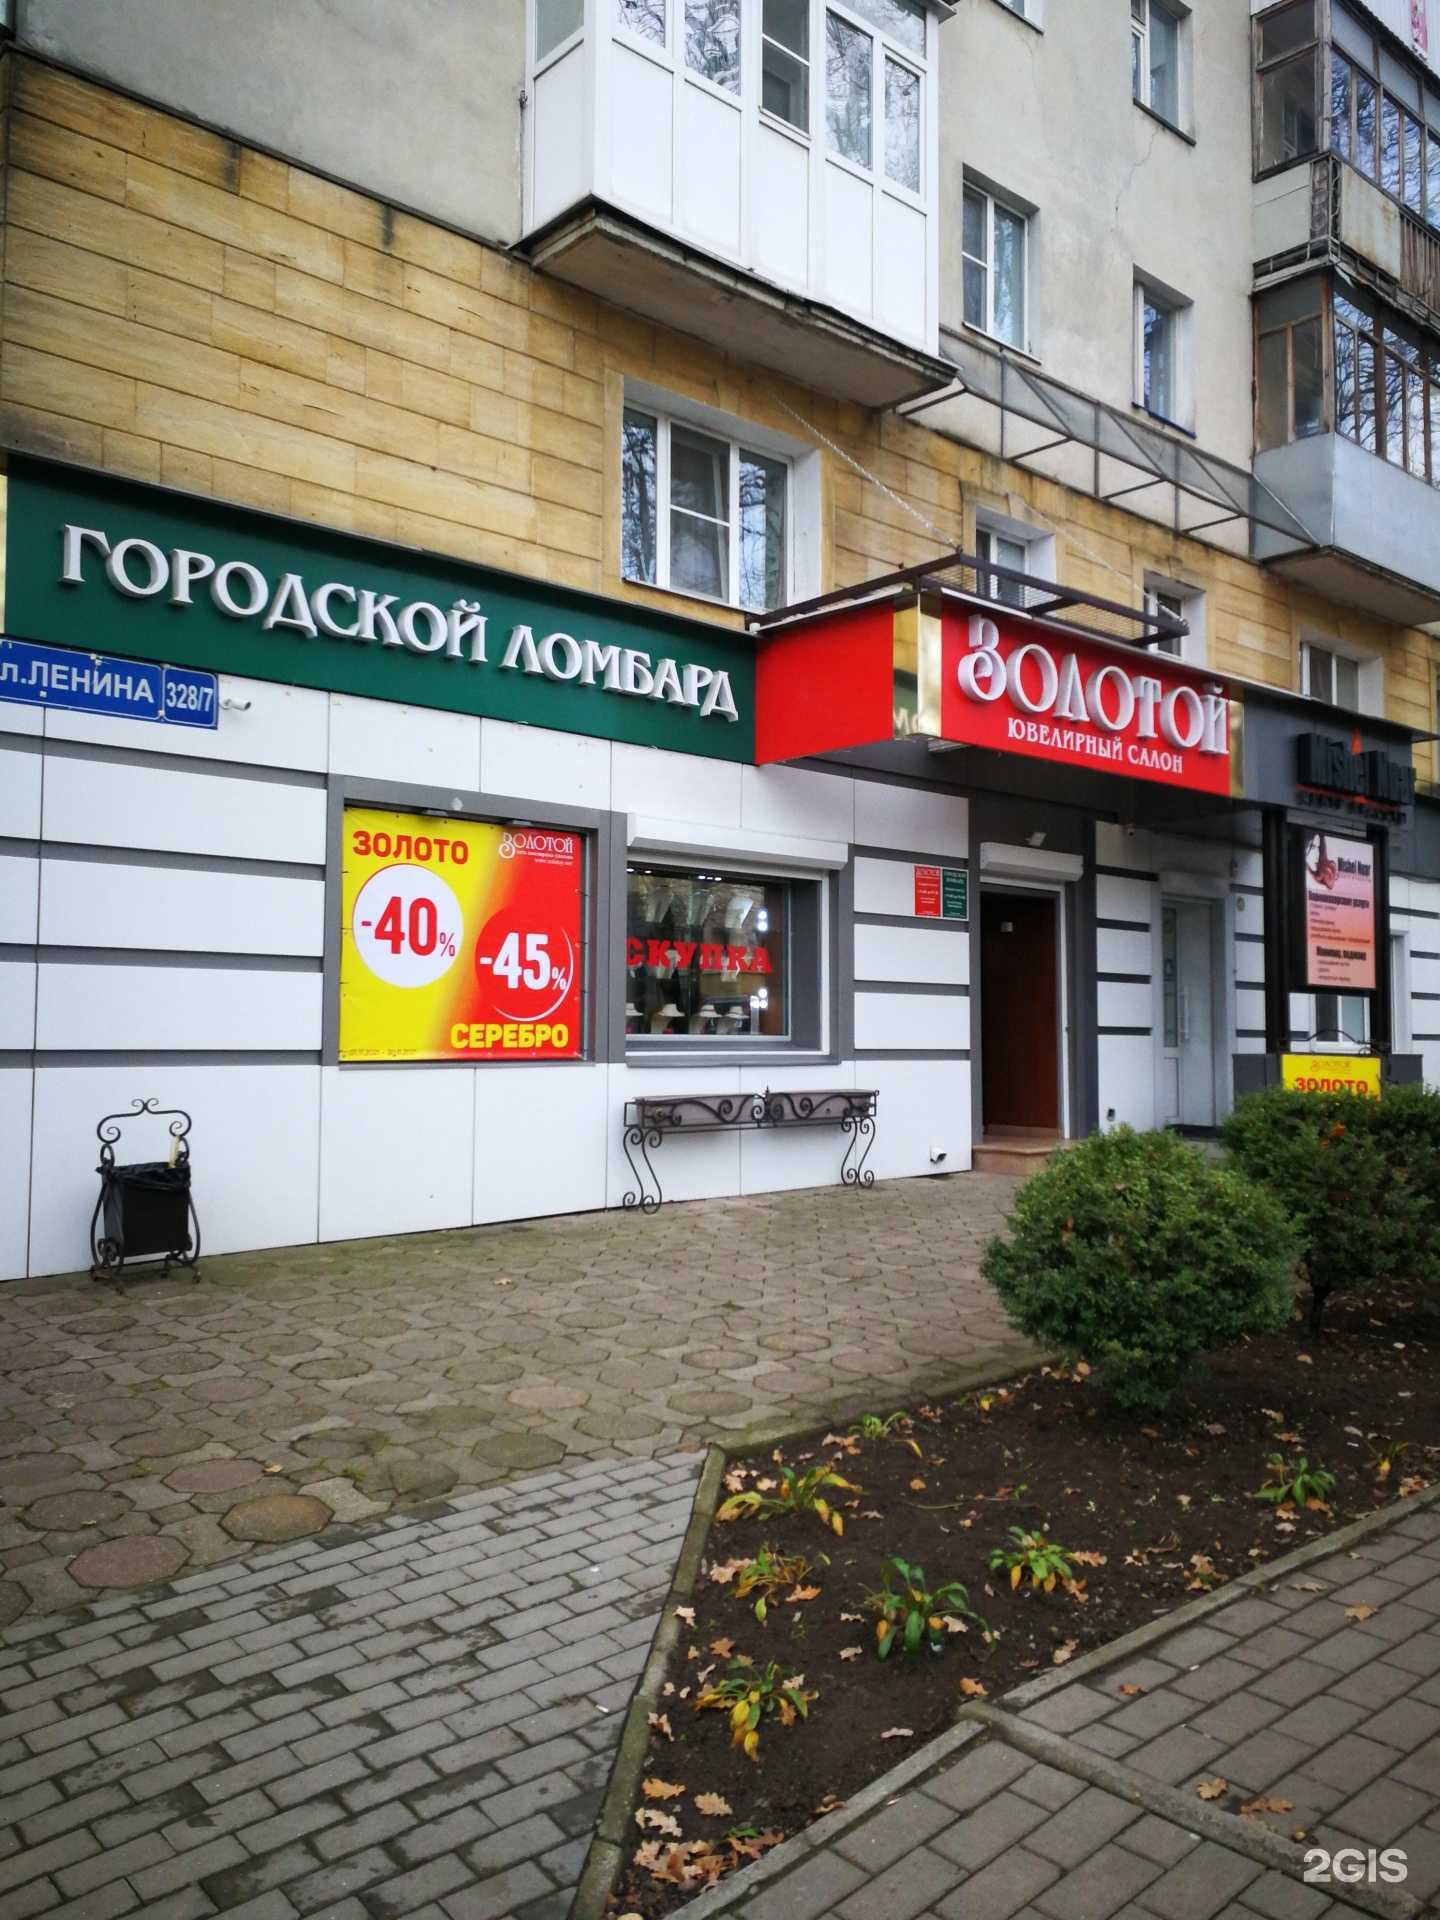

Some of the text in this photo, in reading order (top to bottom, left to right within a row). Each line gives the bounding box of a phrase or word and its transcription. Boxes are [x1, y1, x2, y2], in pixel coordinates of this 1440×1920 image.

[59, 524, 740, 723] ГОРОДСКОЙ ЛОМБАРД
[165, 682, 214, 712] 328/7
[958, 614, 1230, 755] ЗОЛОТОЙ
[1007, 717, 1183, 774] ЮВЕЛИРНЫЙ САЛОН
[352, 830, 469, 865] ЗОЛОТО
[499, 832, 574, 859] ЗОЛОТОЙ
[361, 896, 456, 957] -40%
[480, 932, 567, 991] -45%
[625, 936, 773, 973] СКУПКА
[450, 1023, 569, 1049] СЕРЕБРО
